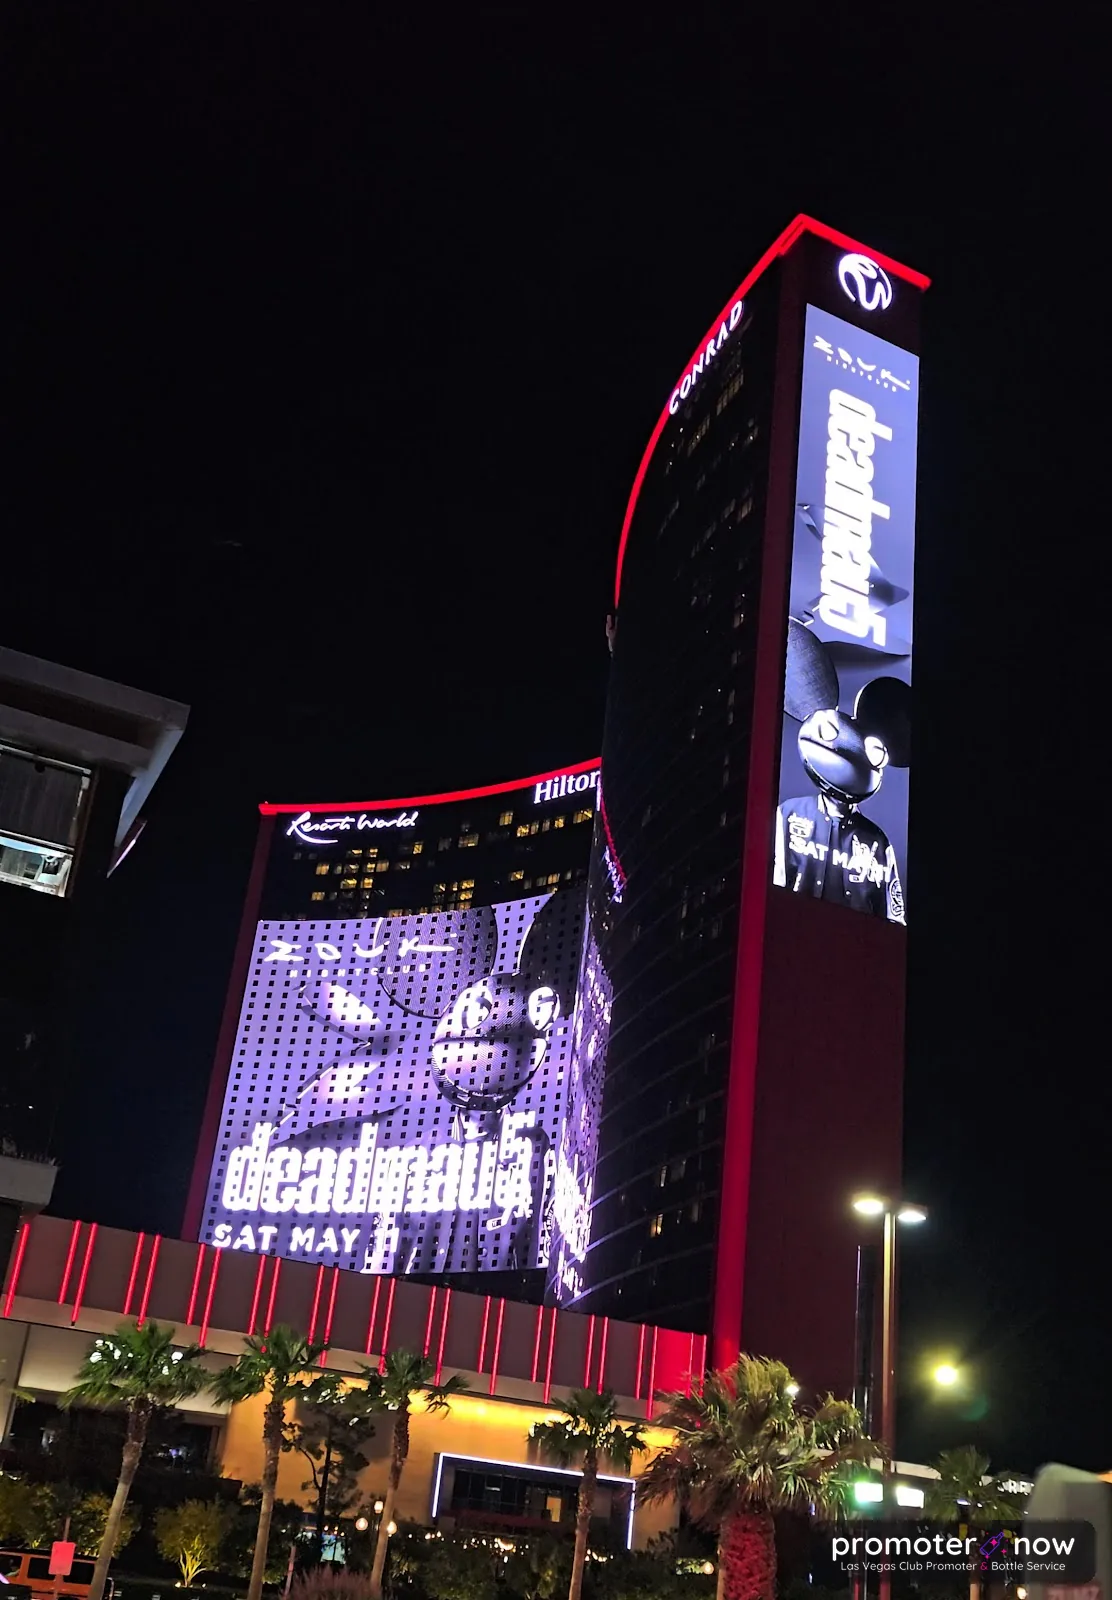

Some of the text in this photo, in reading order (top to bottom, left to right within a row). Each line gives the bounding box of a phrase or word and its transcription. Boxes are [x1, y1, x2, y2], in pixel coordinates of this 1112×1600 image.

[669, 300, 743, 415] CONRAD
[819, 389, 893, 646] deadmau5
[357, 811, 419, 830] World
[221, 1111, 536, 1215] deadmau5
[212, 1223, 277, 1248] SAT
[290, 1226, 360, 1252] MAY
